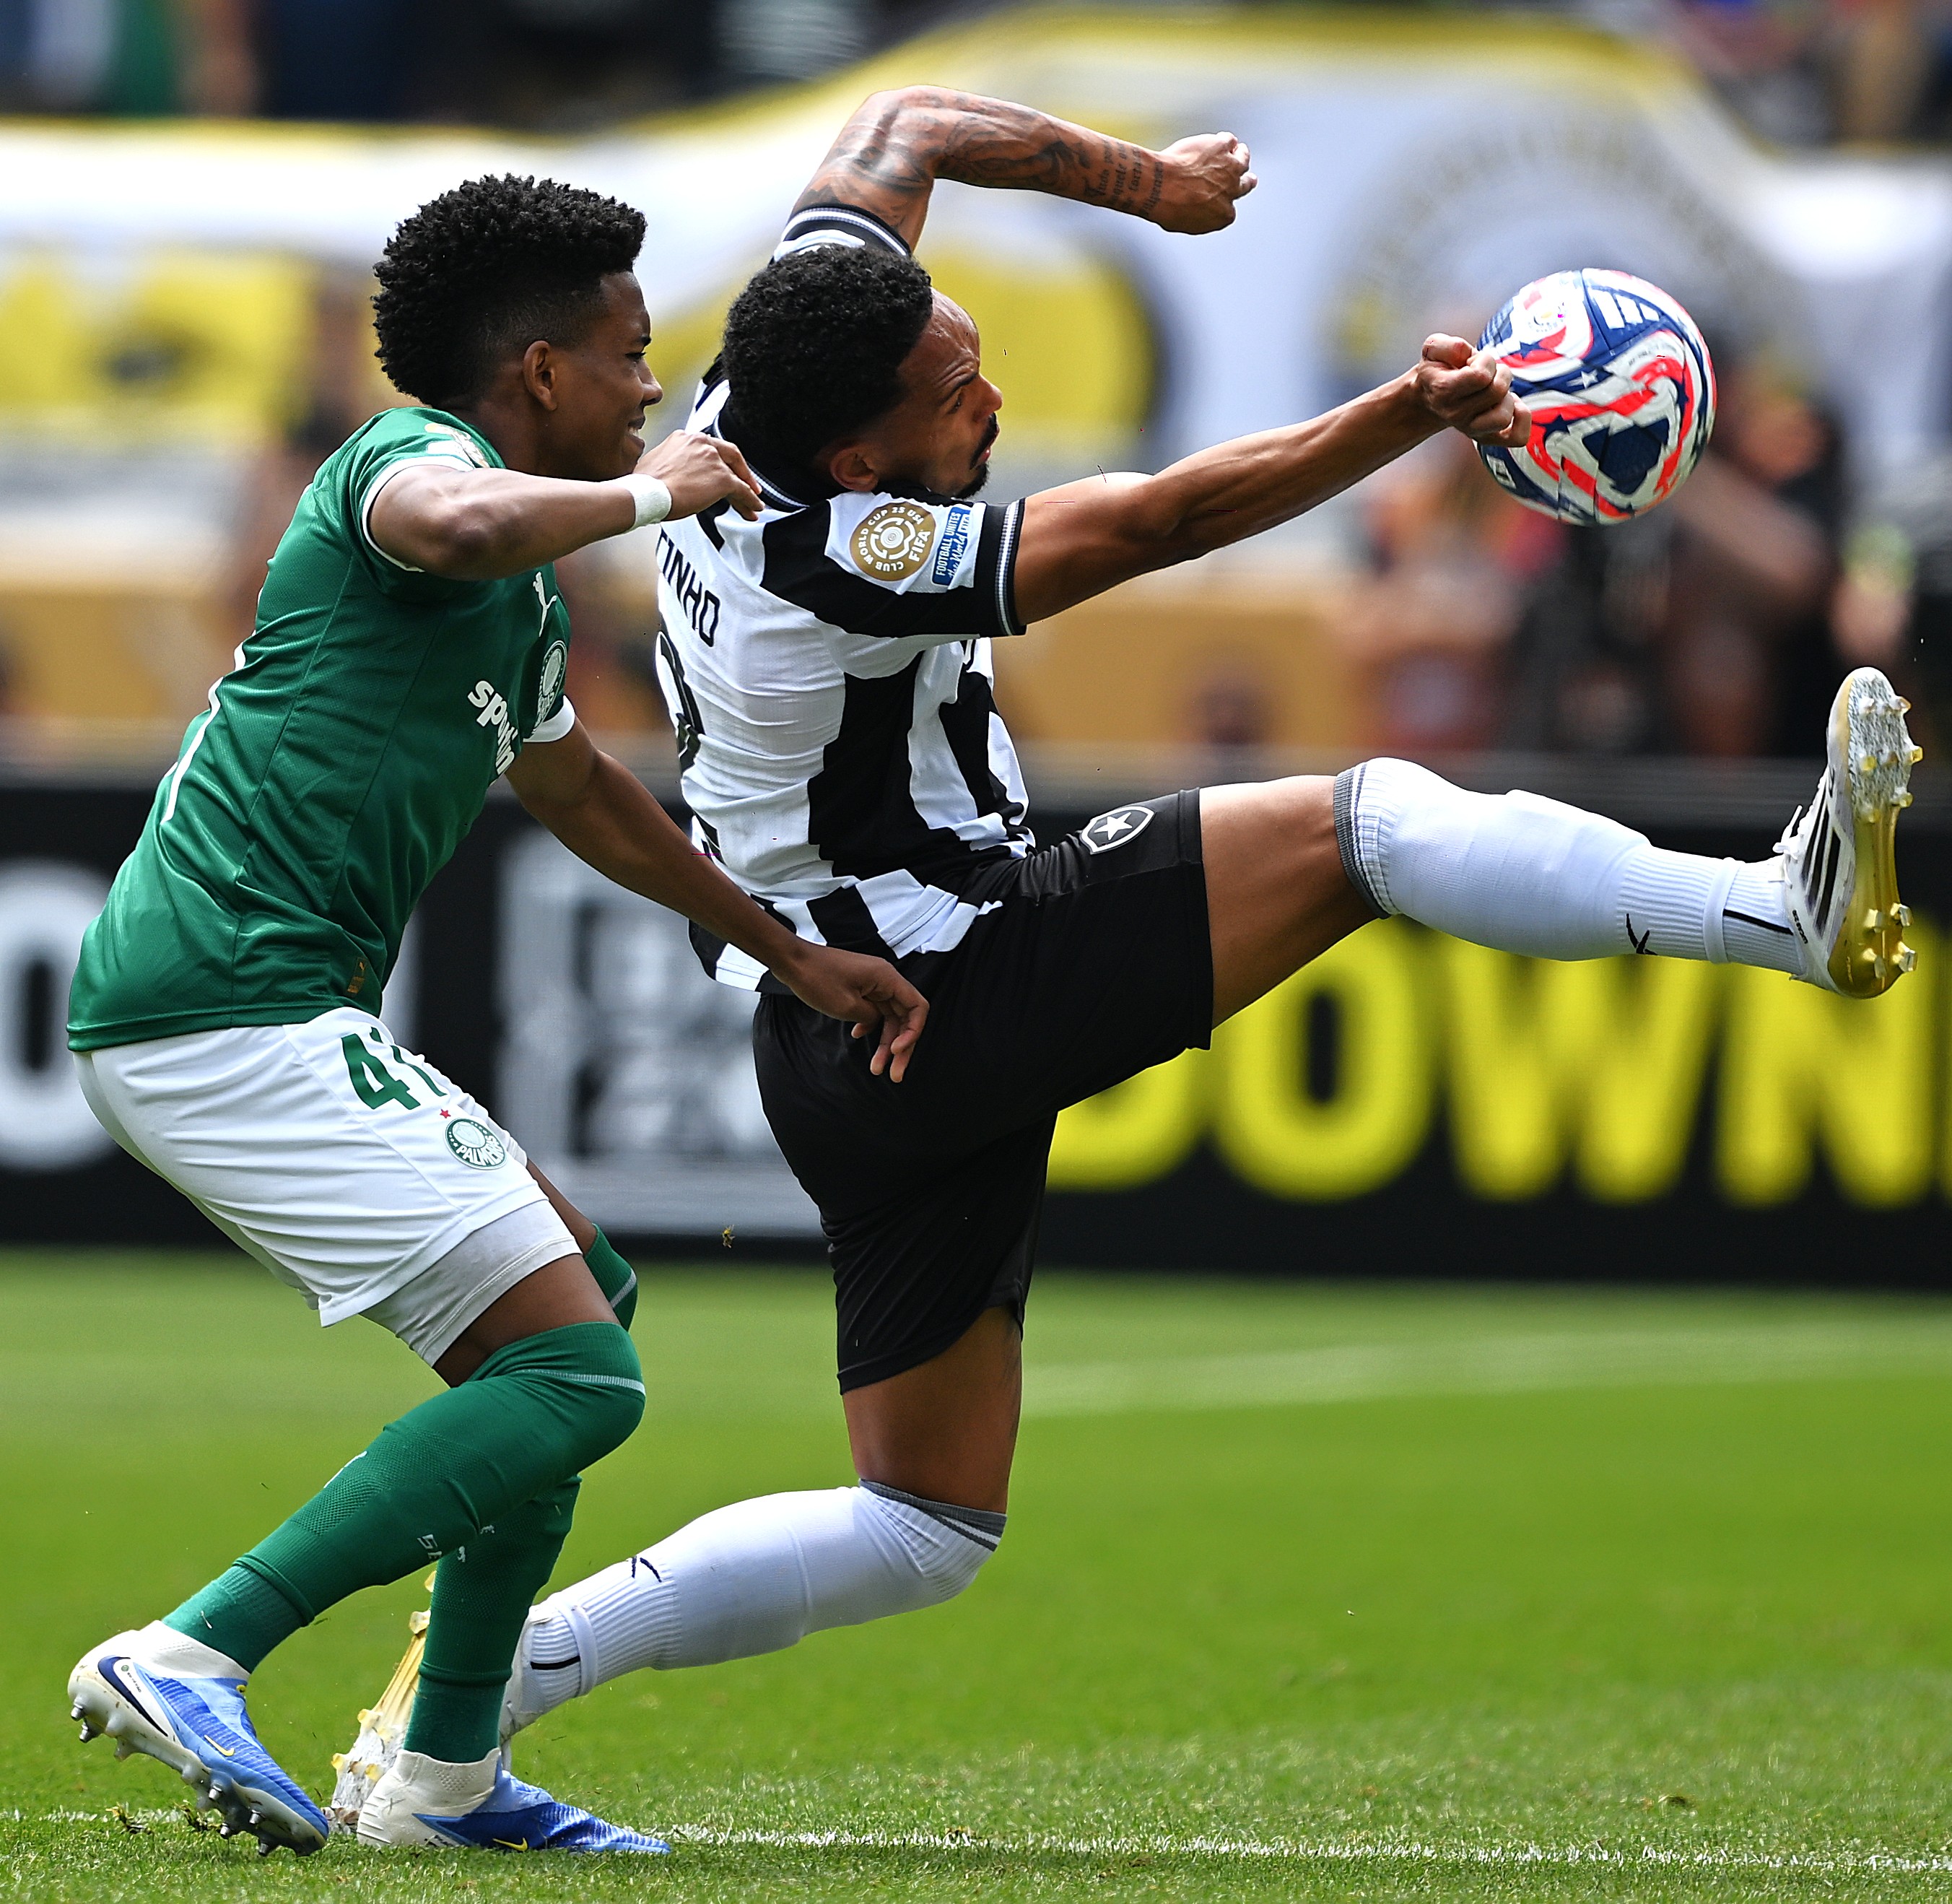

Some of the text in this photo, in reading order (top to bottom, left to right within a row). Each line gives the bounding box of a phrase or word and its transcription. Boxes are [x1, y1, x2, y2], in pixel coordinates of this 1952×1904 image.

[868, 509, 888, 526] CUP
[907, 509, 924, 525] USA
[858, 528, 873, 565] WORLD
[908, 531, 931, 562] FIFA
[936, 512, 962, 576] FOOTBALL UNITES
[950, 532, 967, 562] World
[875, 561, 904, 572] CLUB
